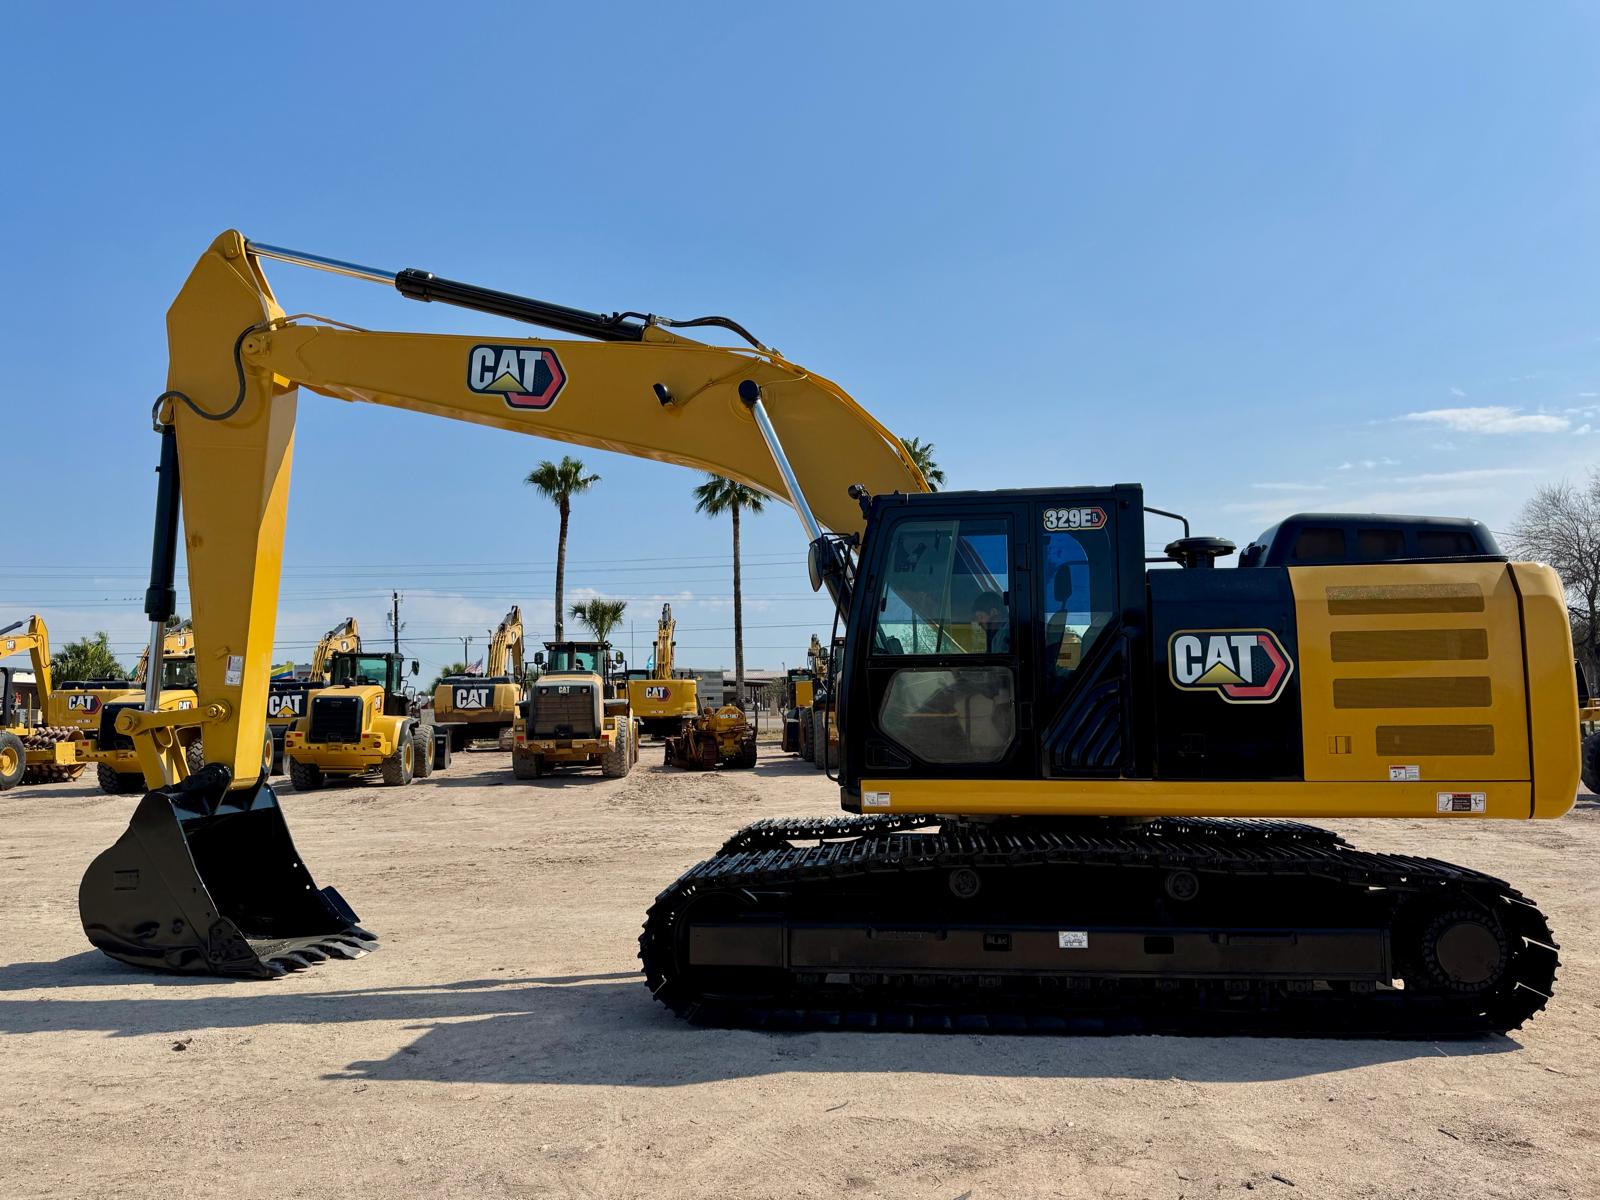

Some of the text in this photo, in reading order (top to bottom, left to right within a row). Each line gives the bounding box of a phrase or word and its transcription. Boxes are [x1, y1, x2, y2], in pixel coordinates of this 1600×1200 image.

[471, 347, 542, 393] CAT
[1046, 509, 1091, 528] 329E
[1174, 635, 1258, 683] CAT
[456, 688, 489, 709] CAT
[558, 686, 570, 694] CAT
[645, 687, 665, 698] CAT
[68, 695, 94, 711] CAT
[268, 694, 303, 716] CAT
